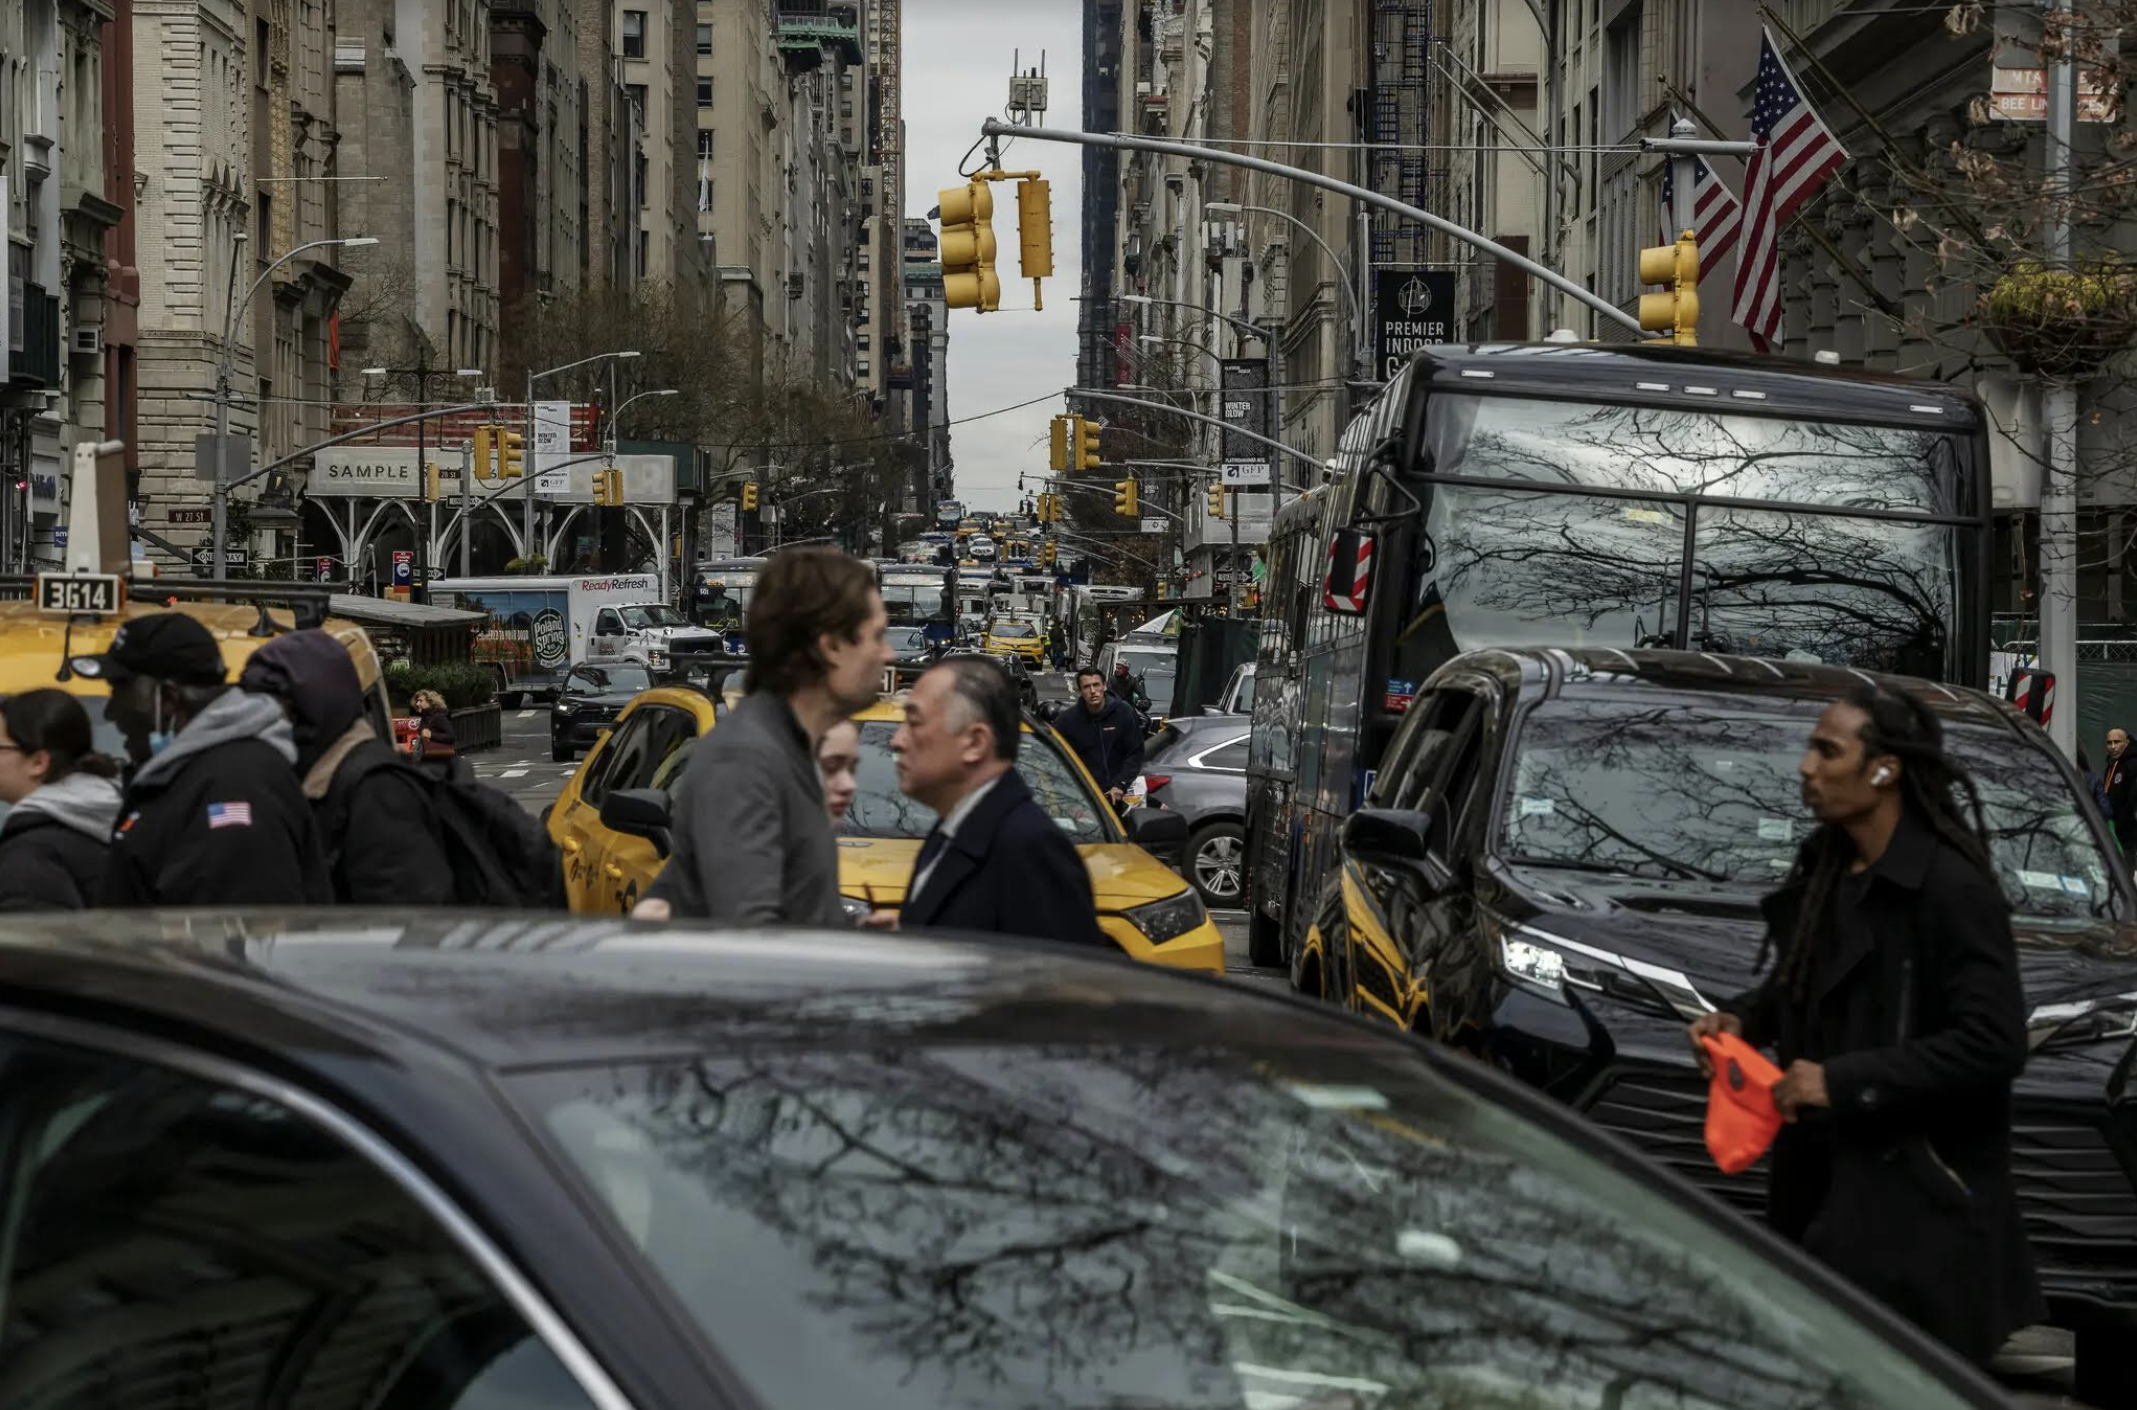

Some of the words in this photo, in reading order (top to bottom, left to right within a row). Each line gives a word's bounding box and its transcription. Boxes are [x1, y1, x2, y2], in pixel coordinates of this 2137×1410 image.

[2012, 71, 2042, 85] MTA
[2001, 98, 2026, 110] BEE
[2031, 98, 2048, 110] LIN
[1386, 321, 1444, 336] PREMIER
[1225, 402, 1251, 410] WINTER
[1225, 410, 1244, 418] GLOW
[329, 465, 408, 478] SAMPLE
[175, 512, 183, 521] W
[185, 512, 193, 521] 27
[196, 512, 204, 521] St
[533, 615, 563, 639] Poland
[535, 631, 565, 653] Spring
